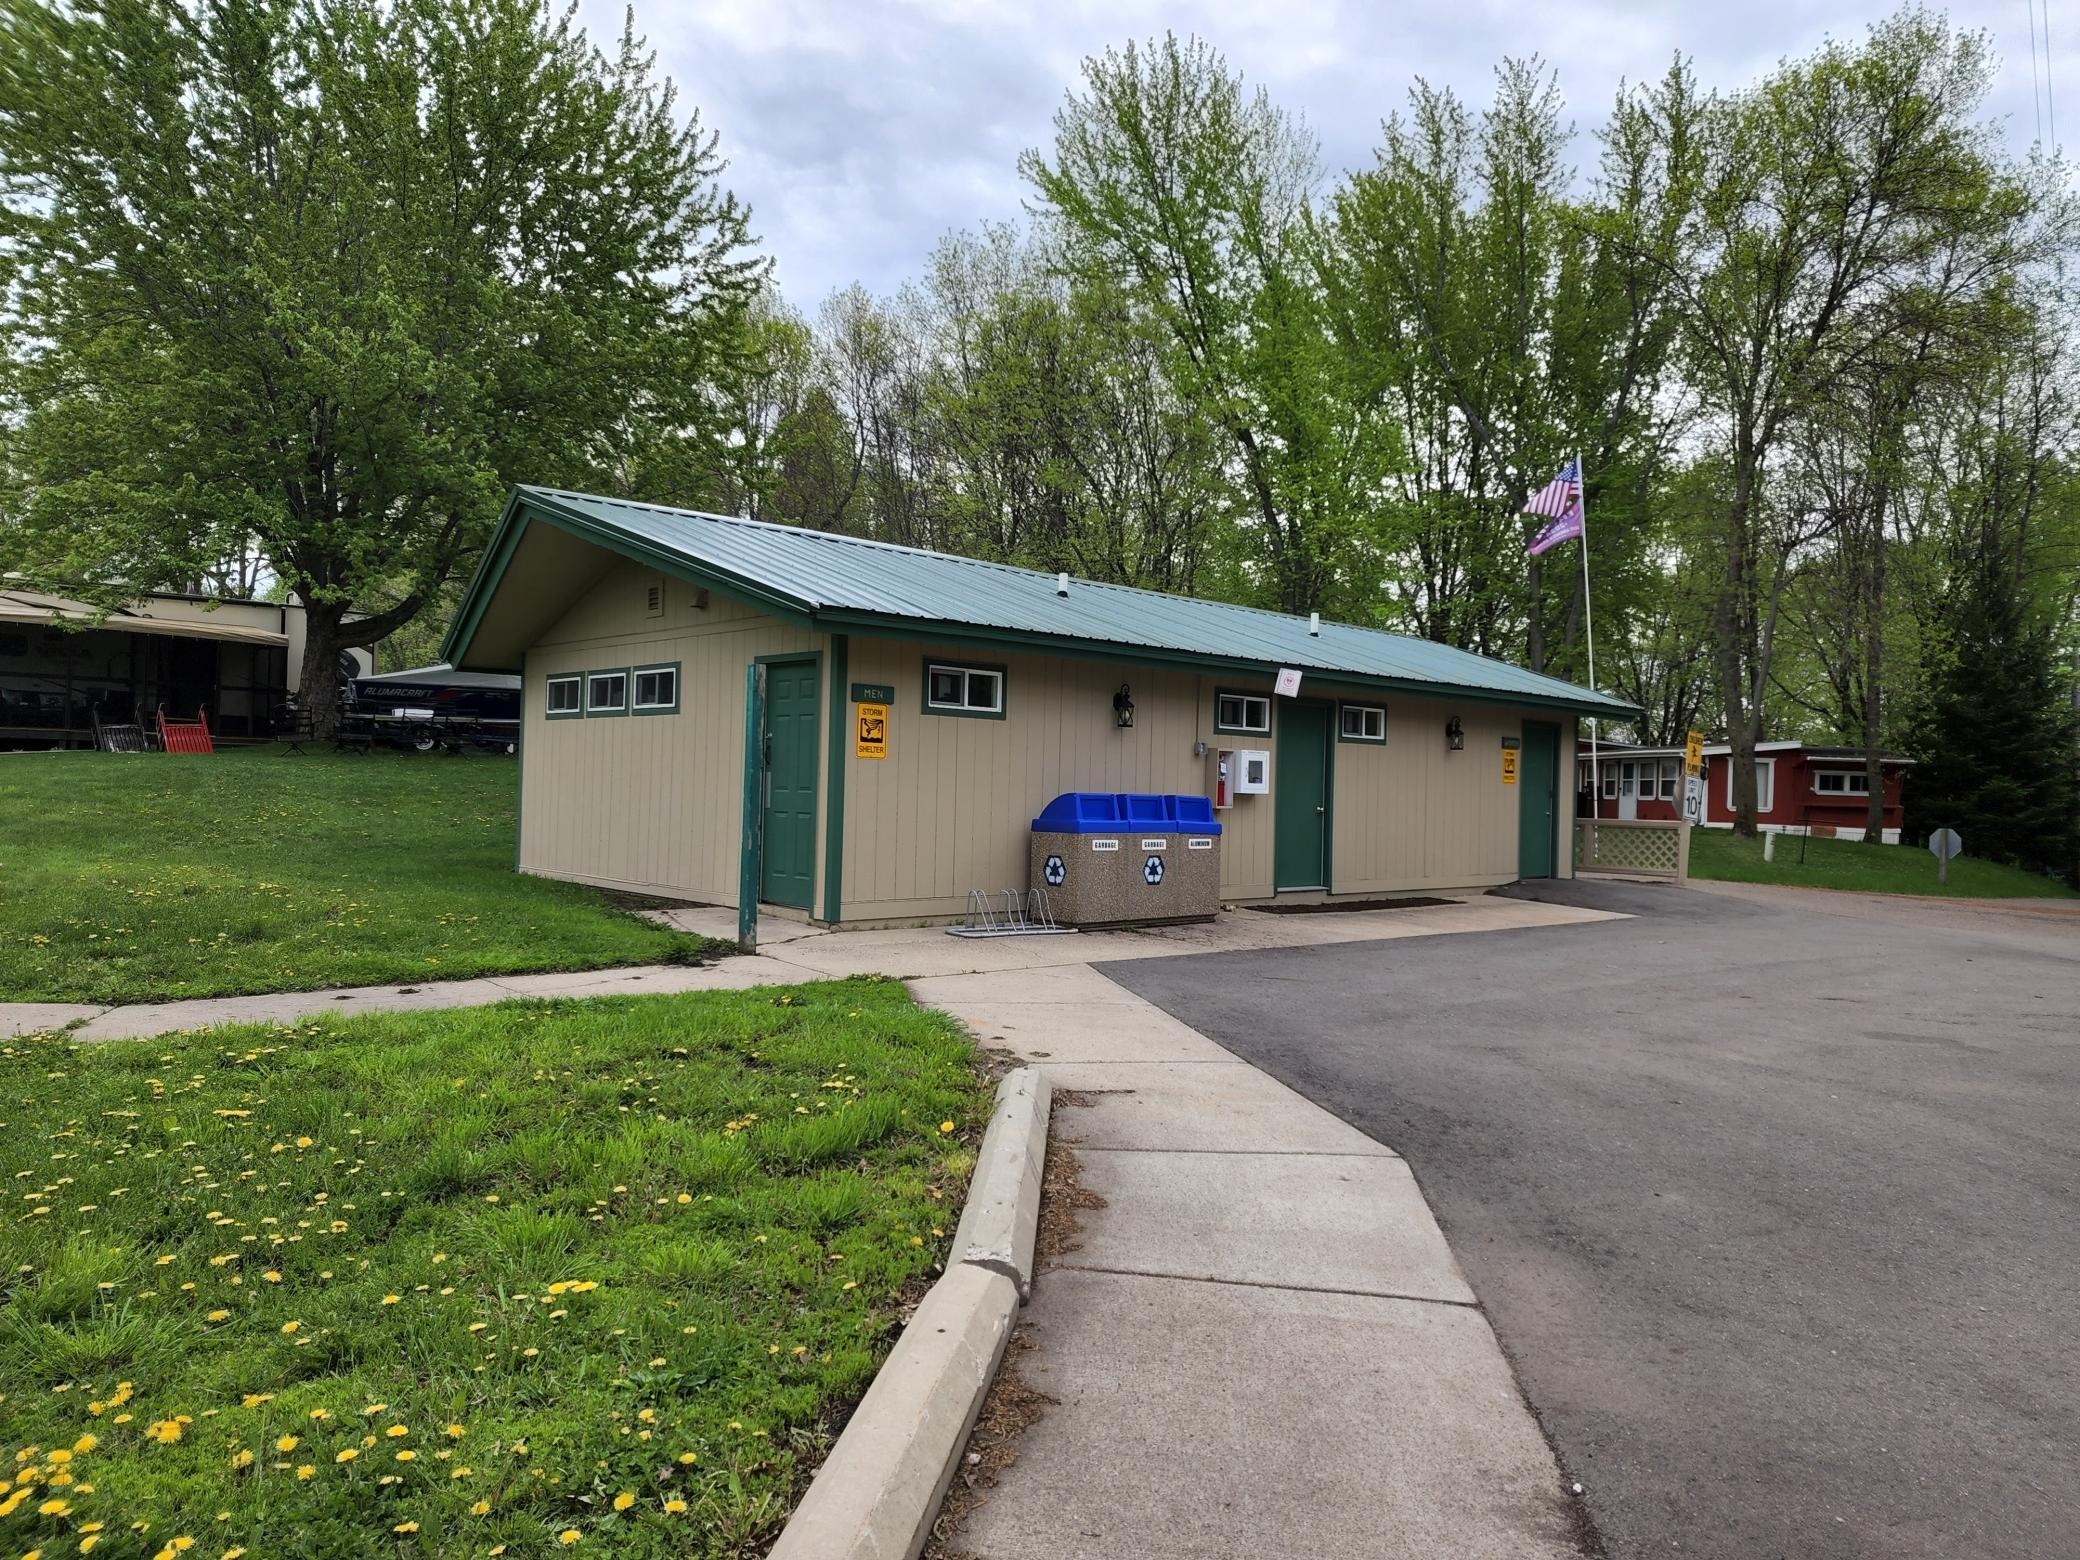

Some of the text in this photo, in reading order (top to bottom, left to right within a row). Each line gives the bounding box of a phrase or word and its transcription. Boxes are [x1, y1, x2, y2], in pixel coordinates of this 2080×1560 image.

[364, 687, 433, 697] ALUMACRAFT
[864, 688, 883, 699] MEN
[862, 708, 883, 716] STORM
[858, 745, 884, 754] SHELTER
[1686, 796, 1698, 815] 10
[1094, 841, 1117, 849] GARBAGE
